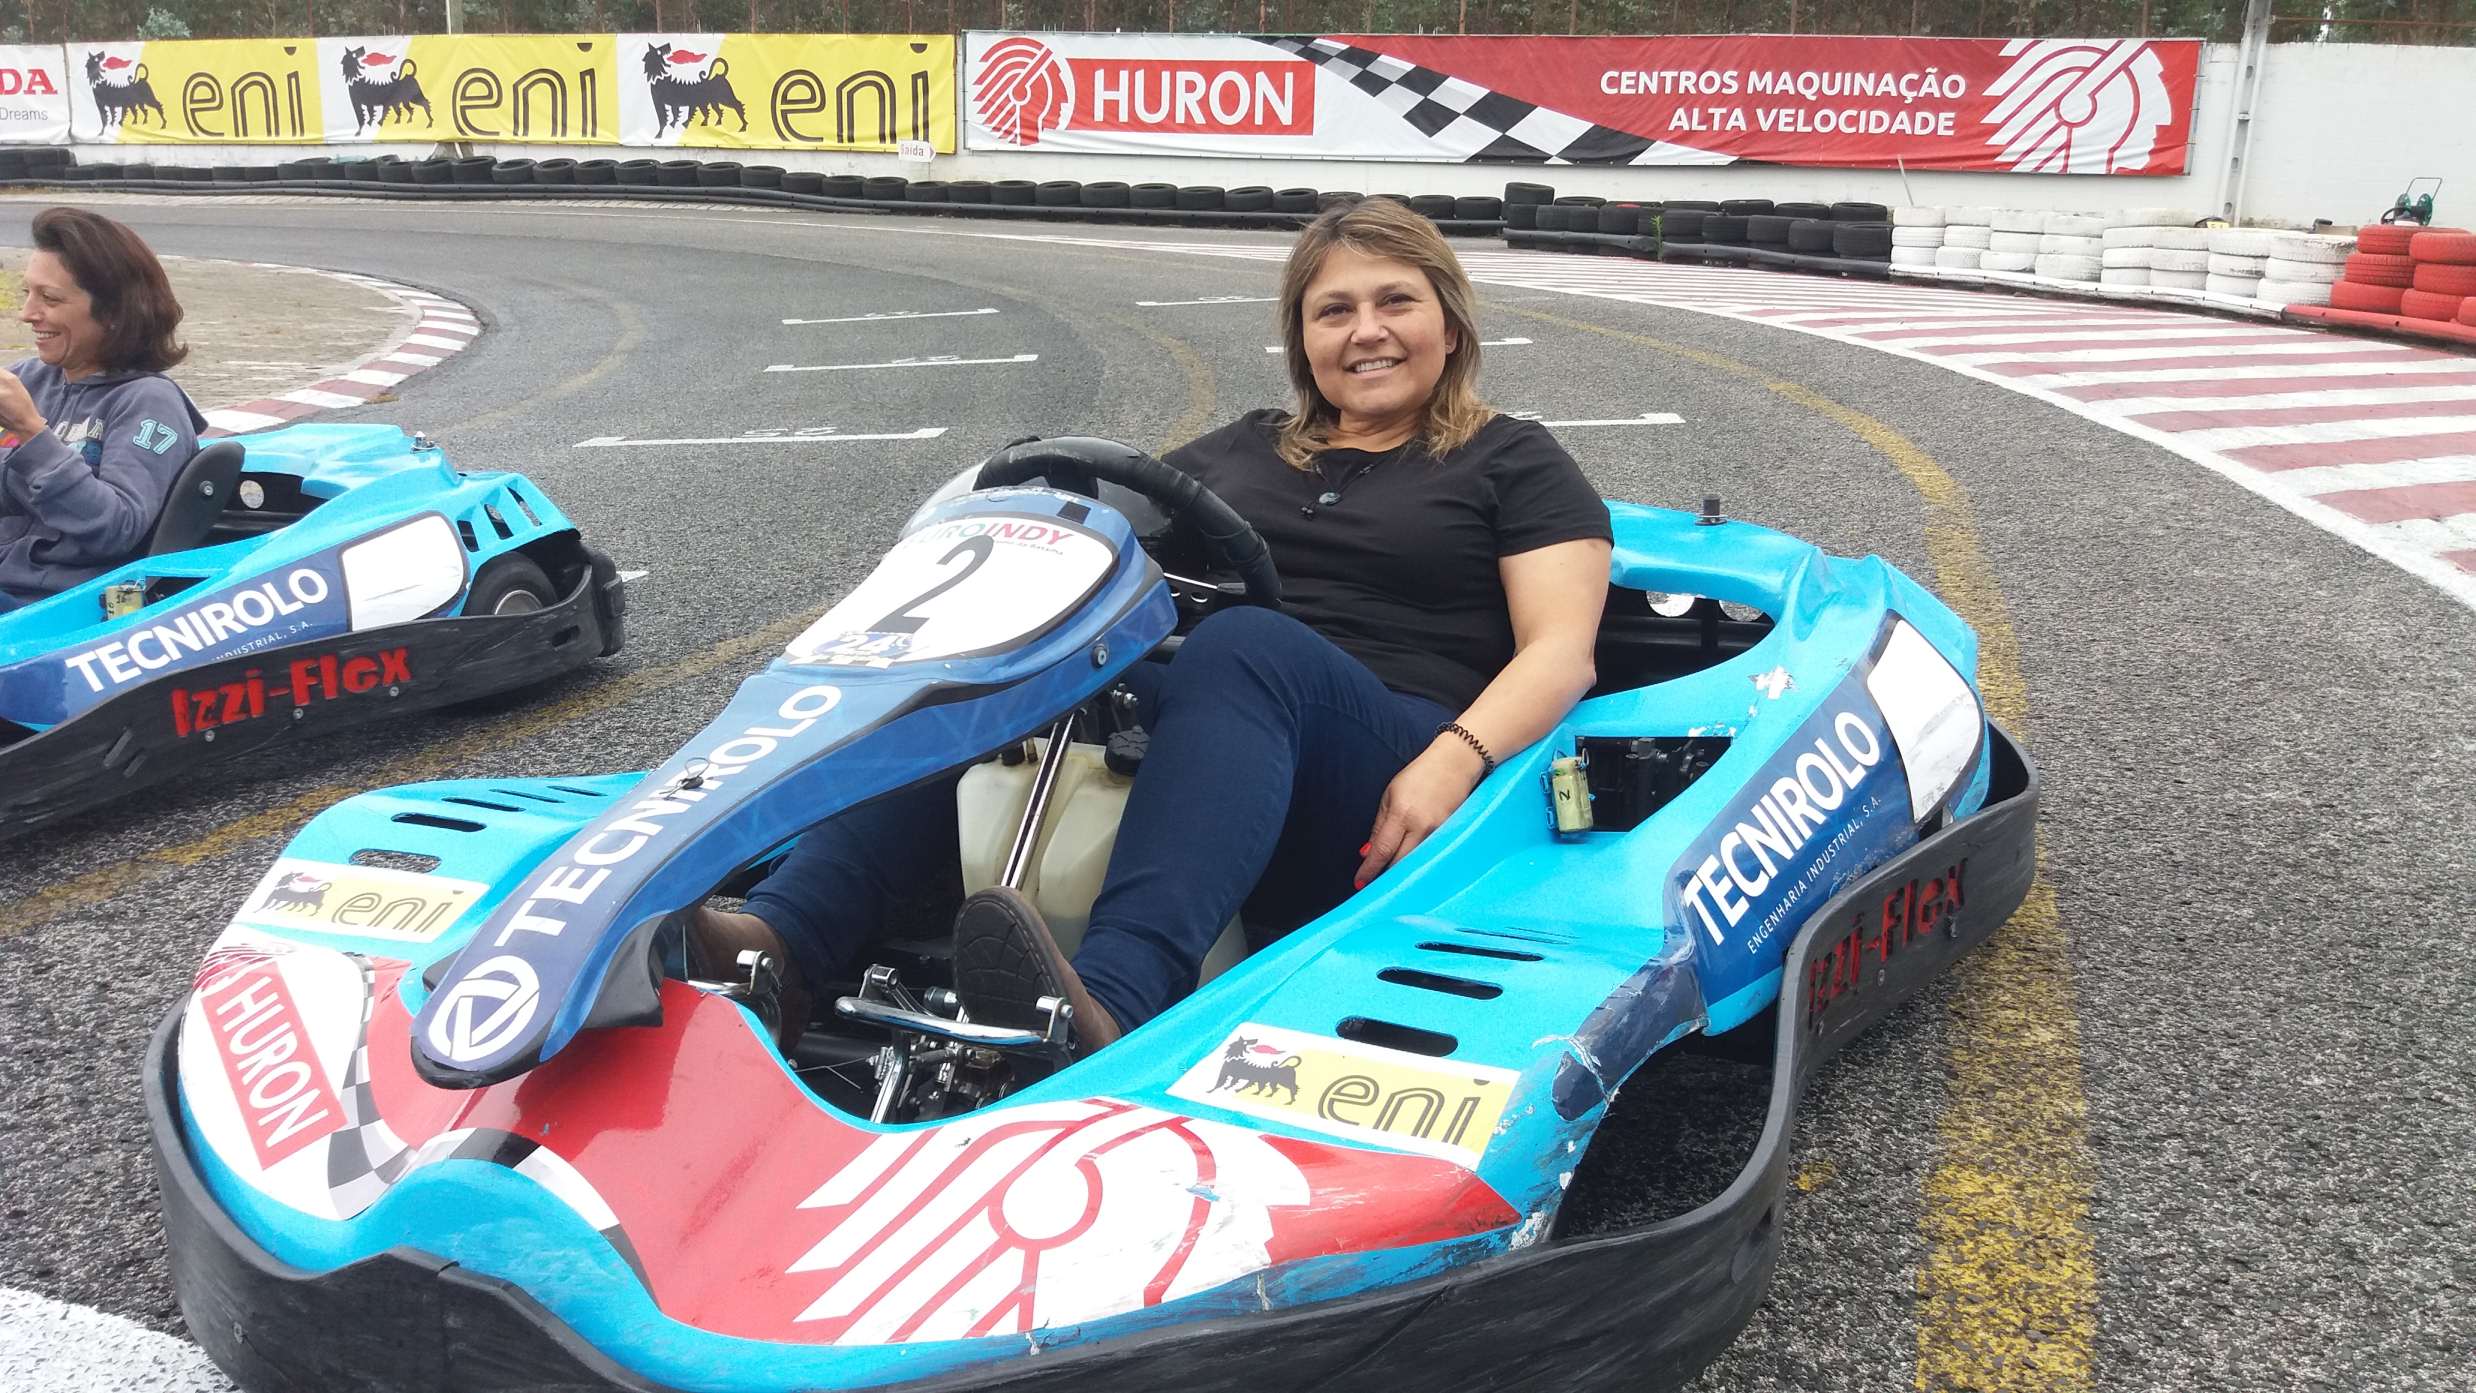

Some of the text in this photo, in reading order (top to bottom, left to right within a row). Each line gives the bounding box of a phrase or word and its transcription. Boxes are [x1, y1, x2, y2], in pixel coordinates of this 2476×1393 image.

[183, 46, 305, 137] eni
[452, 43, 597, 138] eni
[771, 43, 930, 144] eni
[1094, 69, 1294, 126] HURON
[1600, 68, 1966, 105] CENTROS MAQUINAÇÃO
[1669, 107, 1956, 136] ALTA VELOCIDADE
[132, 419, 178, 455] 17
[67, 568, 329, 693] TECNIROLO
[866, 535, 994, 634] 2
[494, 685, 842, 947] TECNIROLO
[1683, 711, 1880, 946] TECNIROLO
[332, 890, 463, 933] eni
[1747, 796, 1881, 954] ENGENHARIA INDUSTRIAL, S.A.
[217, 976, 328, 1148] HURON
[1318, 1074, 1490, 1146] eni
